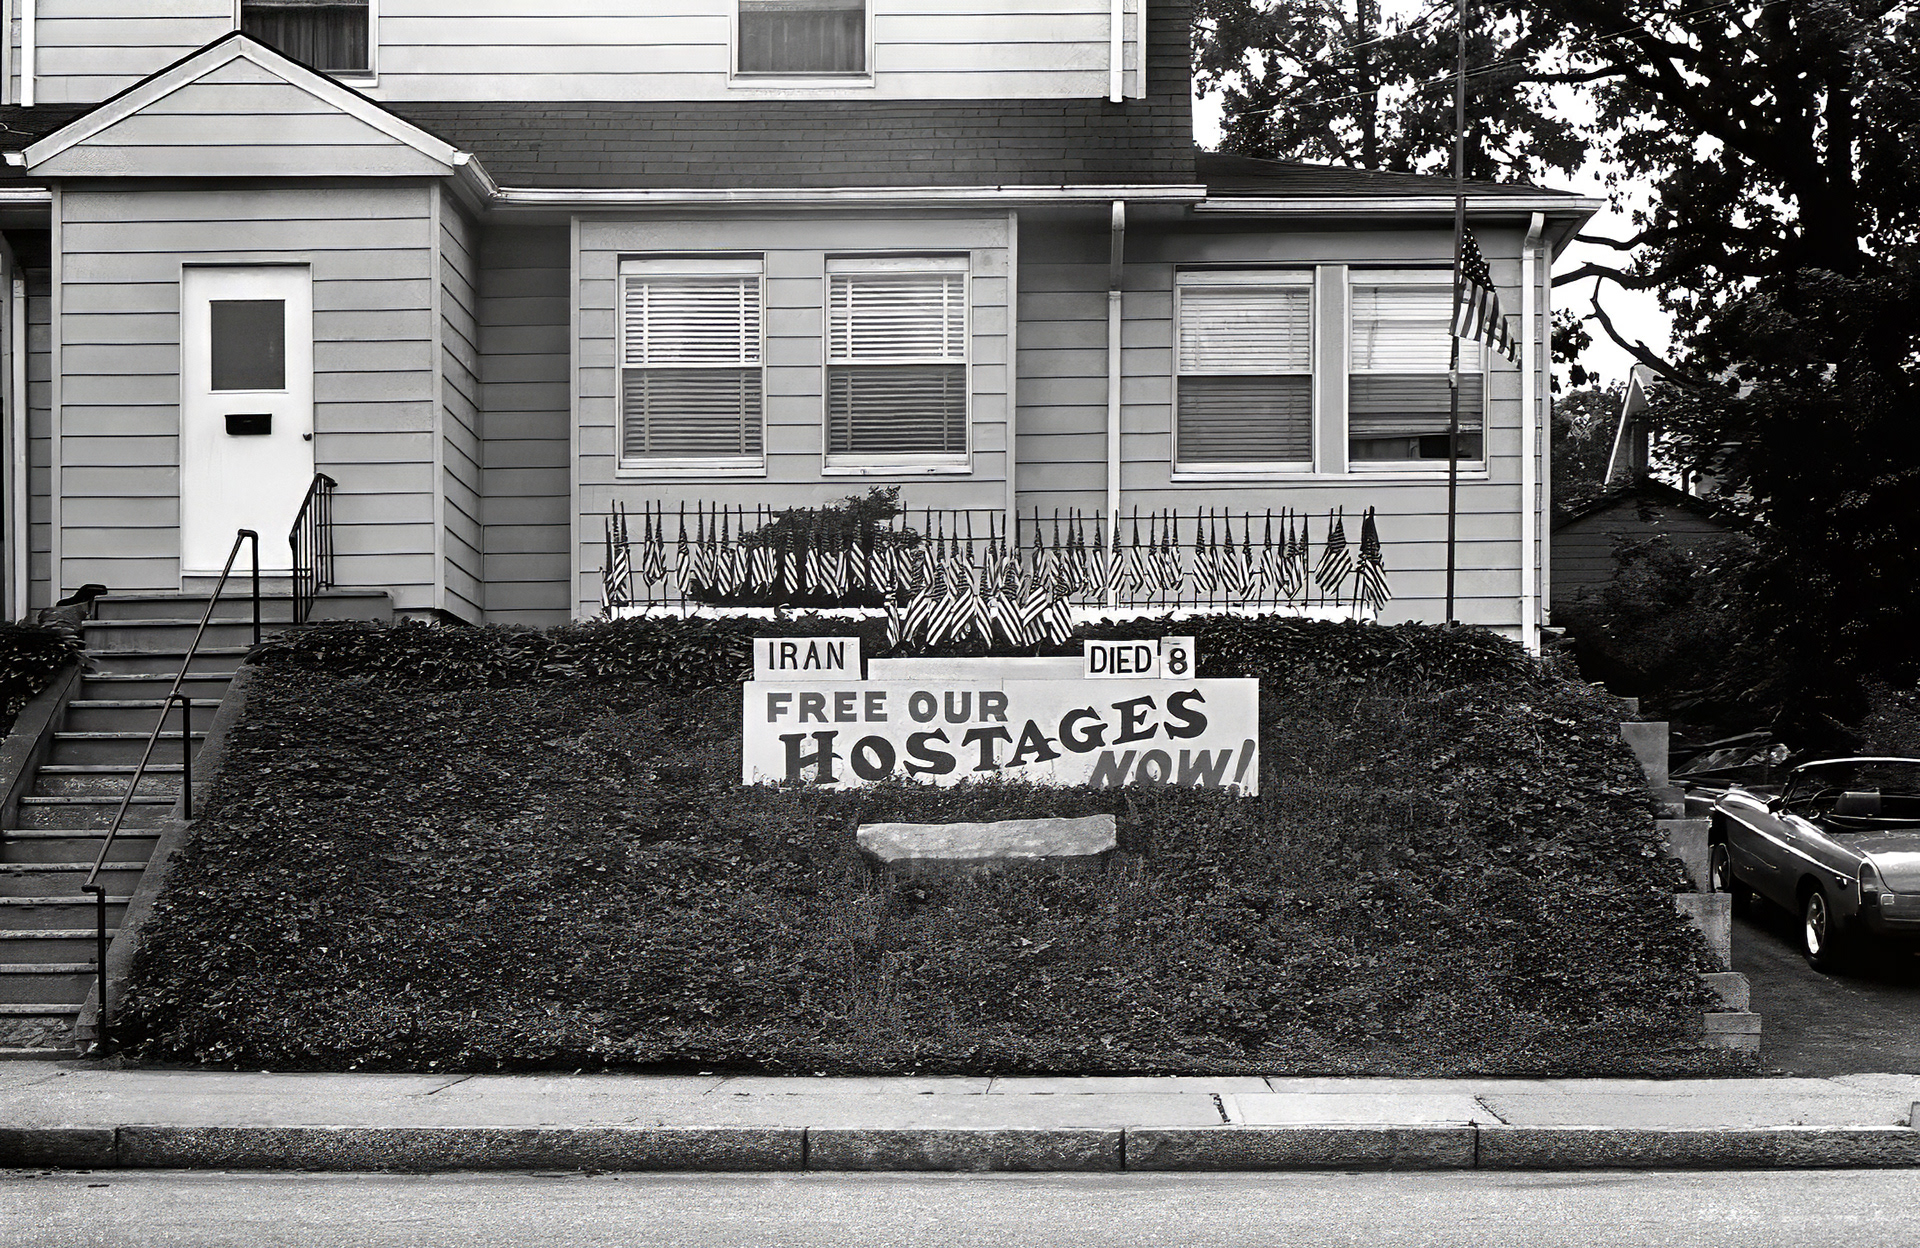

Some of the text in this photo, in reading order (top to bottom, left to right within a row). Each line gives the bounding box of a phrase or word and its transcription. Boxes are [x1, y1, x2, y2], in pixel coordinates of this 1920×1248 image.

[768, 640, 845, 670] IRAN
[1090, 646, 1188, 675] DIED 8
[767, 690, 1009, 724] FREE OUR
[779, 688, 1208, 784] HOSTAGES
[1088, 738, 1256, 790] NOW!
